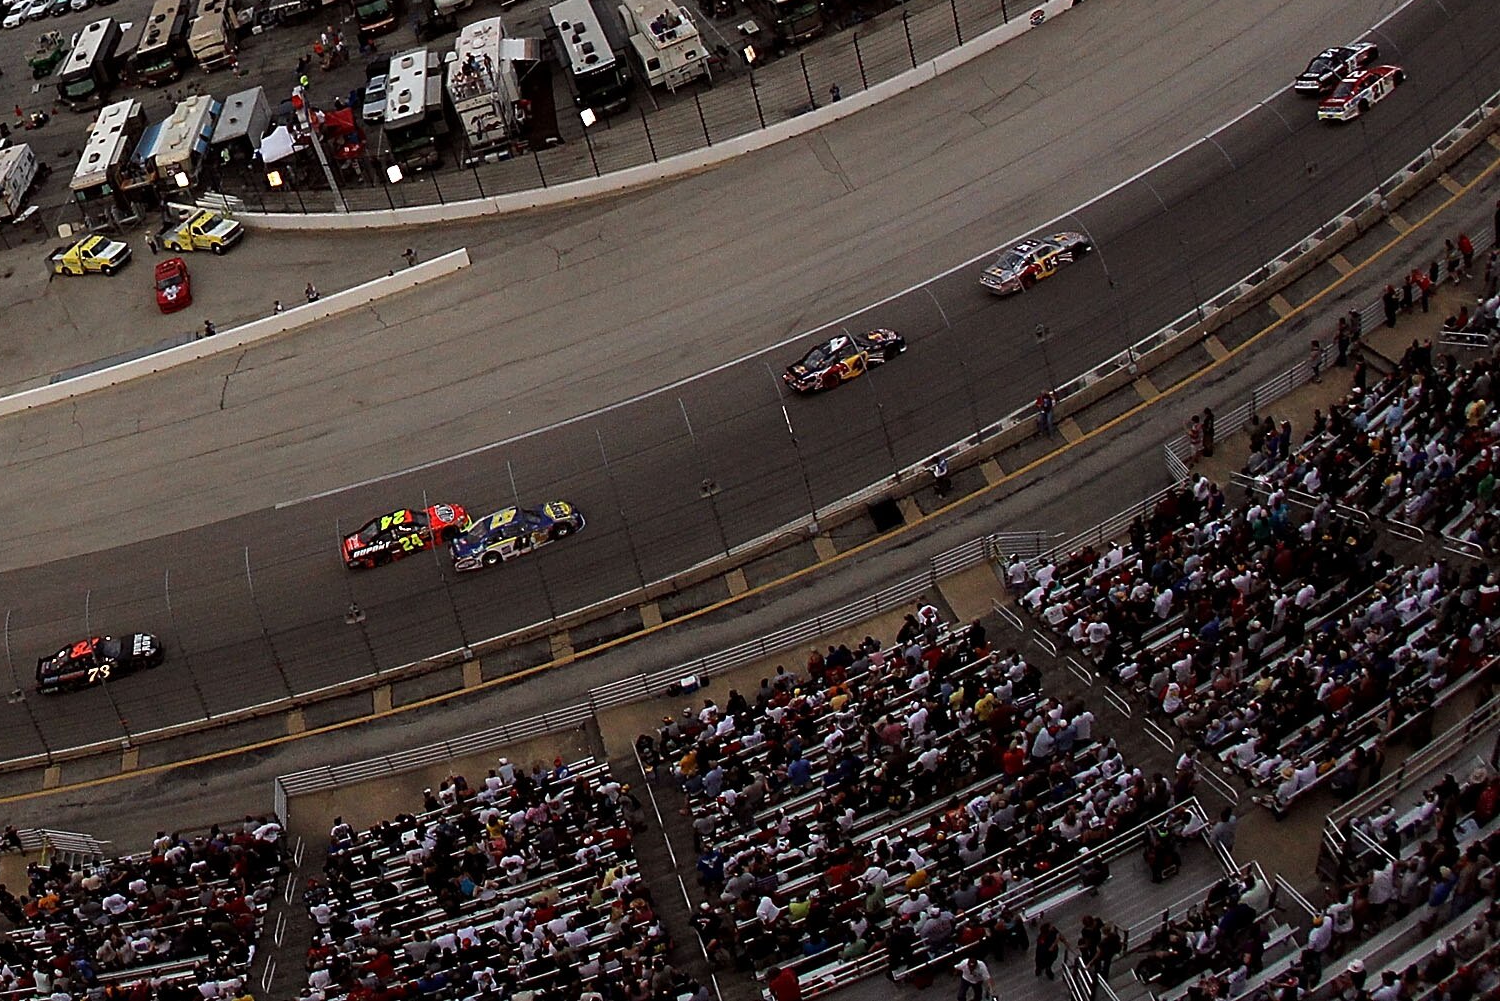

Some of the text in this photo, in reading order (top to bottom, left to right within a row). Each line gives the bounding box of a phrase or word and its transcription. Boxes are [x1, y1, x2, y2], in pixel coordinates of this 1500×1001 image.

[1043, 253, 1061, 271] 83
[380, 509, 406, 531] 24
[353, 540, 392, 559] DUPONT
[398, 533, 425, 552] 24
